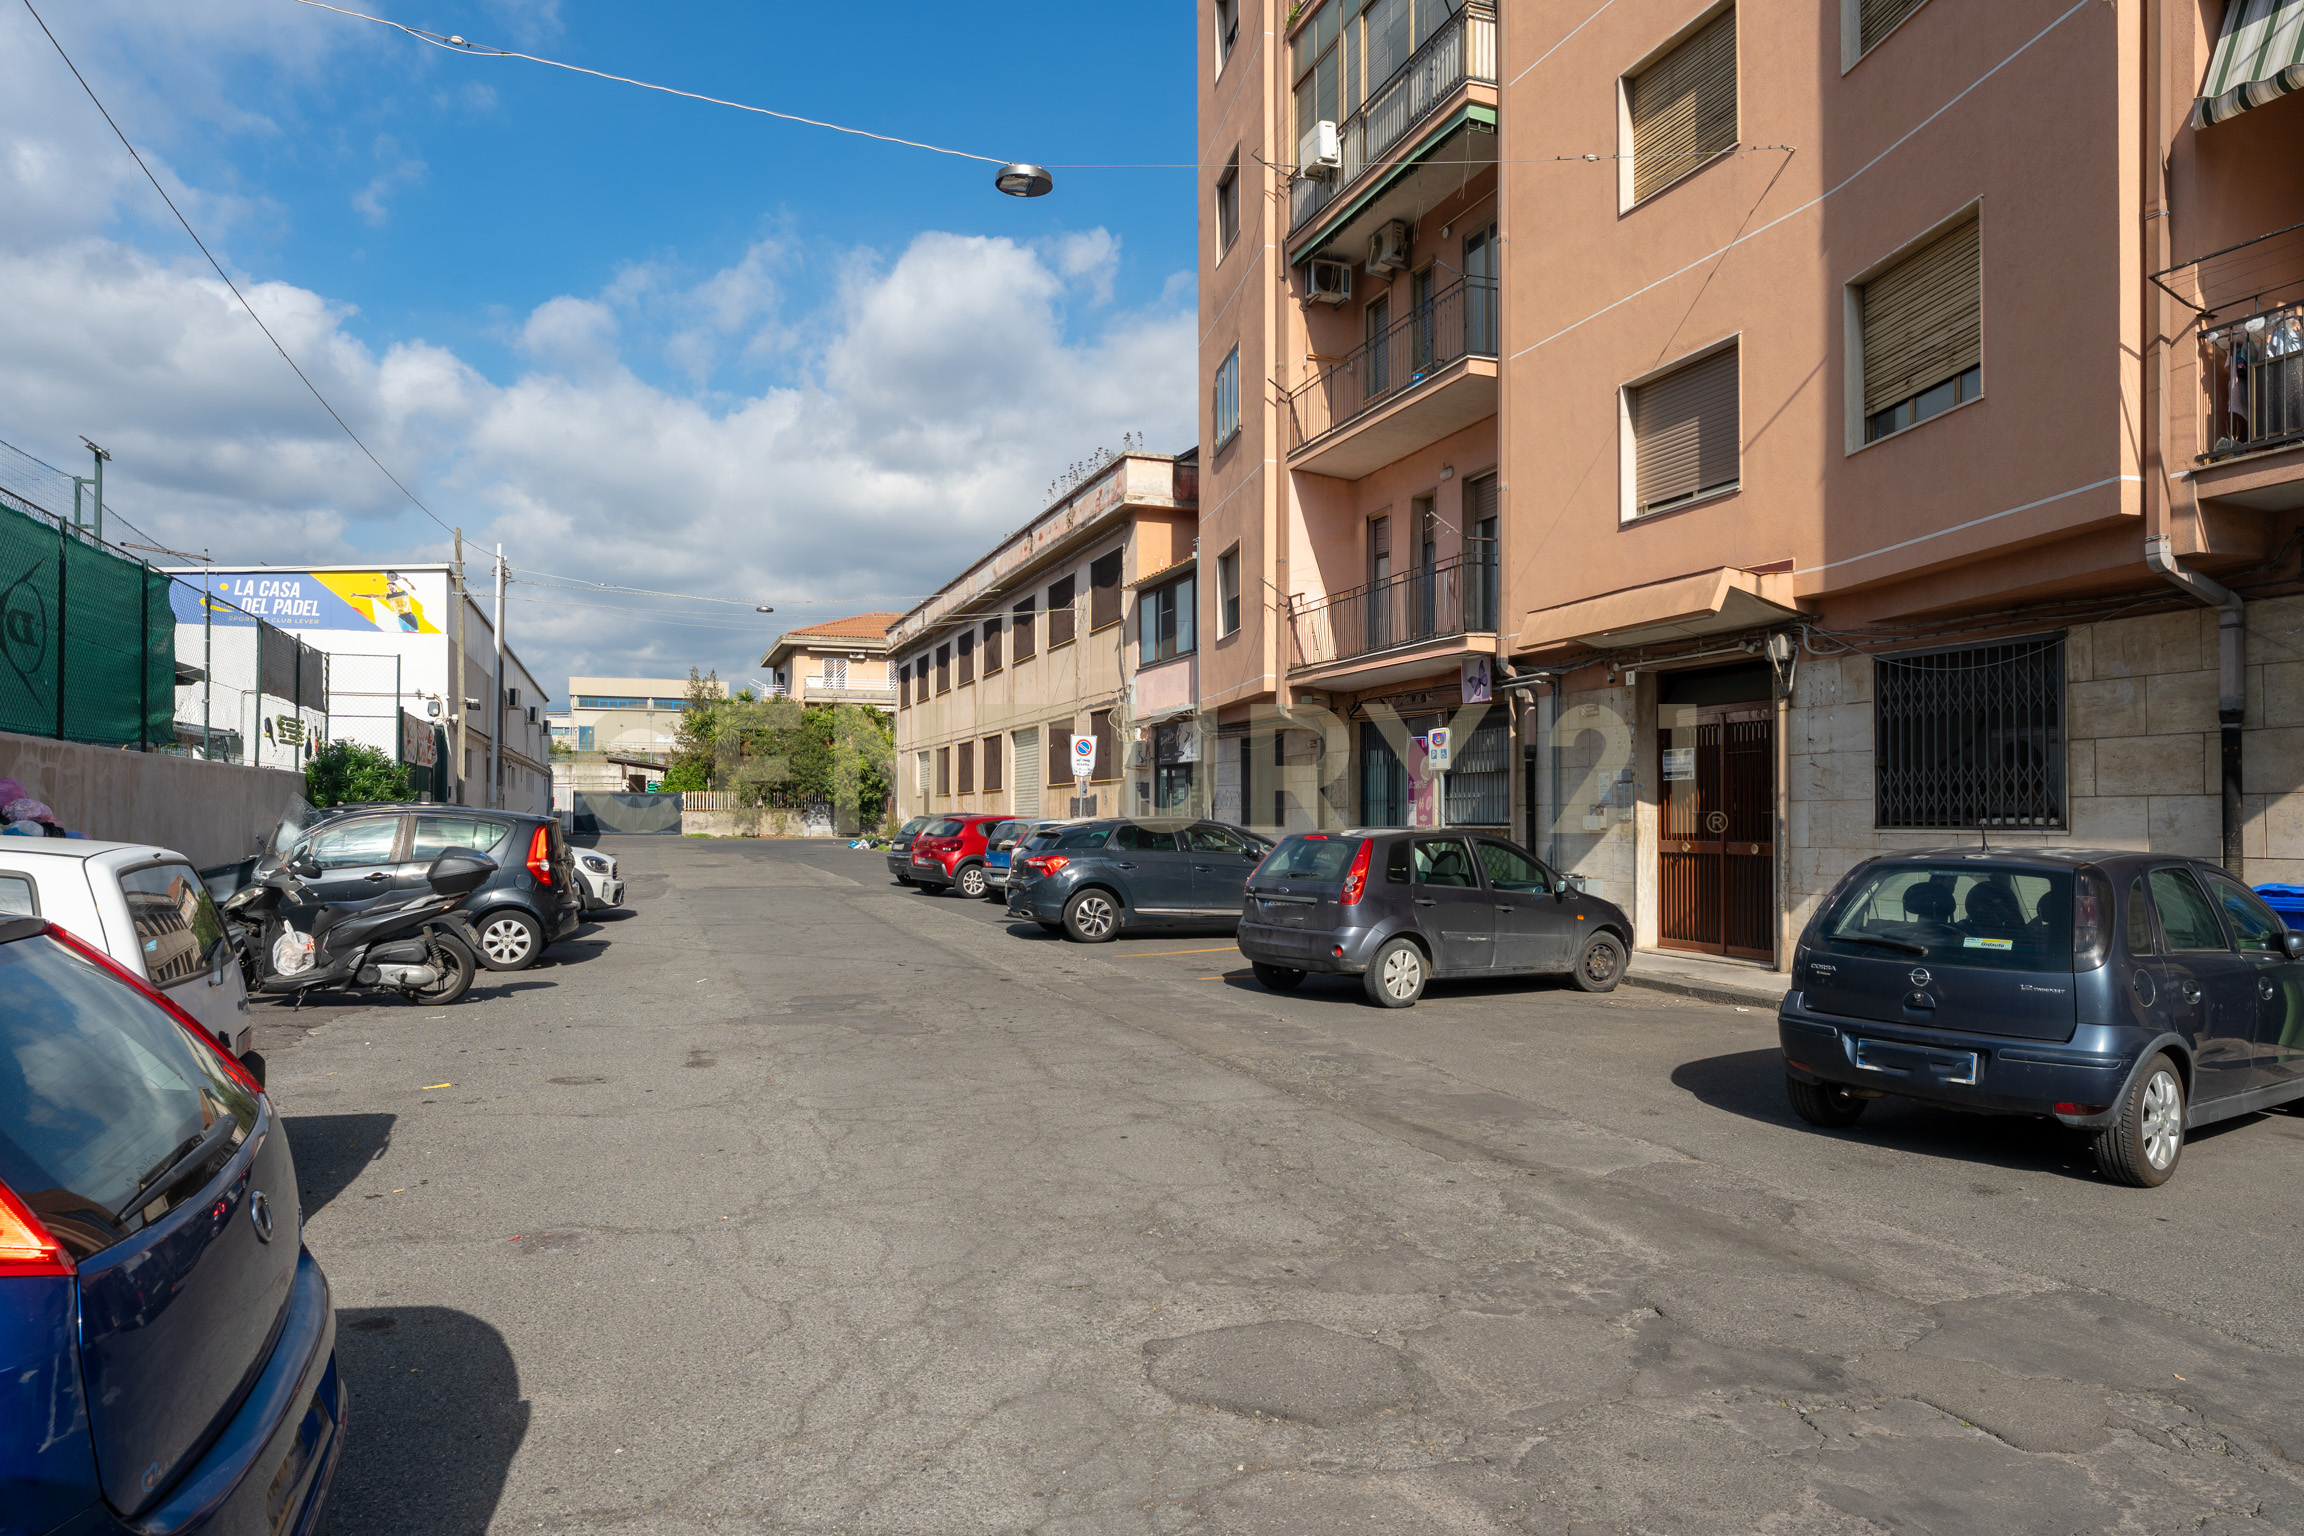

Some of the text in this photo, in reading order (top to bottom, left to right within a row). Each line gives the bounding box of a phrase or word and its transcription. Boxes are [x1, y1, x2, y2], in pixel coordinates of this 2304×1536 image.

[234, 579, 300, 598] LA CASA
[240, 597, 320, 617] DEL PADEL
[1810, 963, 1837, 972] CORSA
